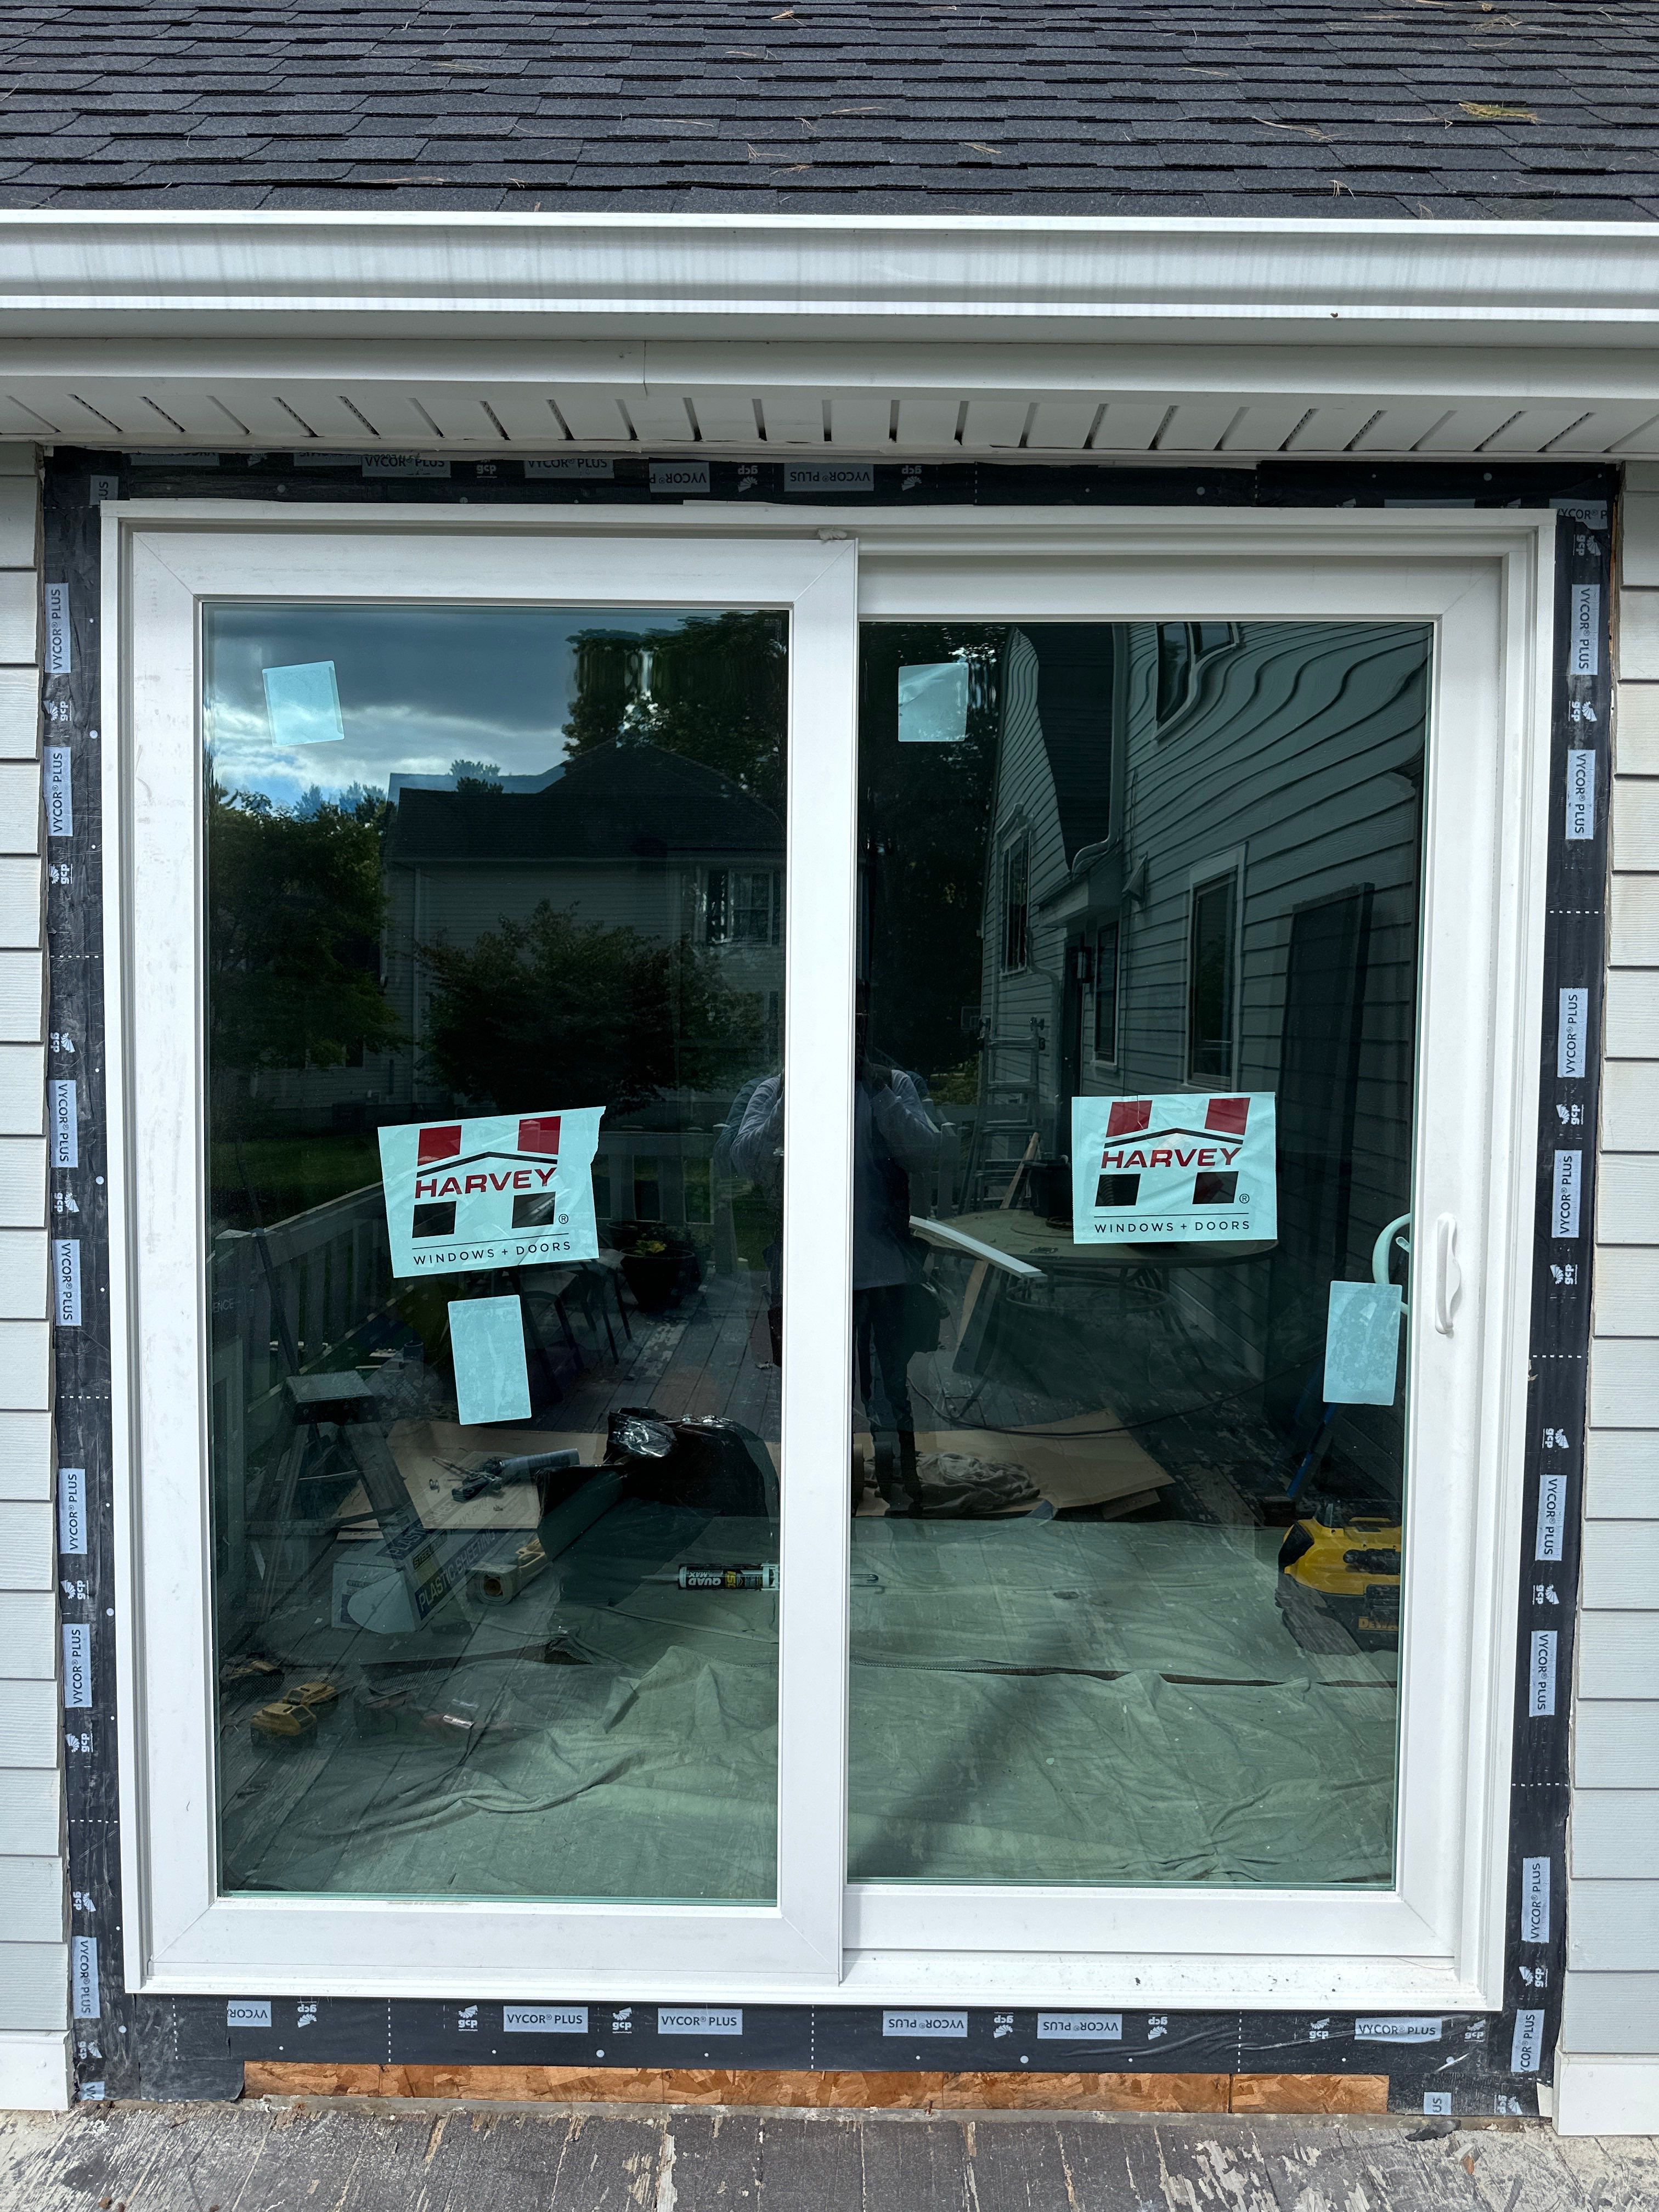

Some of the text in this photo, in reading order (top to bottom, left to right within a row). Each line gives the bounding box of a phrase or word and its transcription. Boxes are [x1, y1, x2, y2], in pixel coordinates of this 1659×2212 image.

[476, 465, 496, 473] gcp
[578, 459, 607, 468] PLUS
[737, 466, 758, 475] gcp
[901, 465, 922, 475] gcp
[790, 472, 819, 481] PLUS
[1576, 534, 1585, 556] gcp
[52, 589, 62, 618] PLUS
[1578, 636, 1589, 670] PLUS
[59, 701, 69, 720] gcp
[1571, 701, 1580, 721] gcp
[52, 753, 63, 781] PLUS
[1575, 802, 1585, 833] PLUS
[60, 864, 70, 884] gcp
[1568, 994, 1578, 1024] PLUS
[50, 1032, 59, 1052] gcp
[1571, 1104, 1581, 1125] gcp
[59, 1132, 69, 1162] PLUS
[1101, 1147, 1242, 1169] HARVEY
[1562, 1155, 1572, 1184] PLUS
[415, 1167, 557, 1198] HARVEY
[54, 1193, 64, 1212] gcp
[1094, 1222, 1173, 1233] WINDOWS
[1195, 1221, 1249, 1231] DOORS
[413, 1249, 494, 1265] WINDOWS
[516, 1242, 571, 1255] DOORS
[1564, 1264, 1574, 1284] gcp
[63, 1290, 73, 1320] PLUS
[1545, 1427, 1555, 1448] gcp
[69, 1474, 78, 1502] PLUS
[1544, 1526, 1554, 1555] PLUS
[76, 1579, 86, 1599] gcp
[419, 1564, 456, 1612] PLASTIC
[688, 1577, 721, 1586] QUAD
[1536, 1584, 1545, 1605] gcp
[71, 1629, 81, 1658] PLUS
[1537, 1680, 1547, 1710] PLUS
[81, 1733, 89, 1751] gcp
[1532, 1863, 1541, 1892] PLUS
[73, 1892, 82, 1911] gcp
[1535, 1968, 1544, 1987] gcp
[81, 1985, 91, 2013] PLUS
[297, 2004, 317, 2013] gcp
[458, 2019, 478, 2029] gcp
[555, 2014, 583, 2024] PLUS
[612, 2021, 632, 2031] gcp
[709, 2016, 737, 2027] PLUS
[888, 2018, 916, 2028] PLUS
[994, 2015, 1014, 2024] gcp
[1043, 2021, 1071, 2030] PLUS
[1148, 2016, 1168, 2025] gcp
[1524, 2014, 1534, 2039] PLUS
[1407, 2027, 1436, 2035] PLUS
